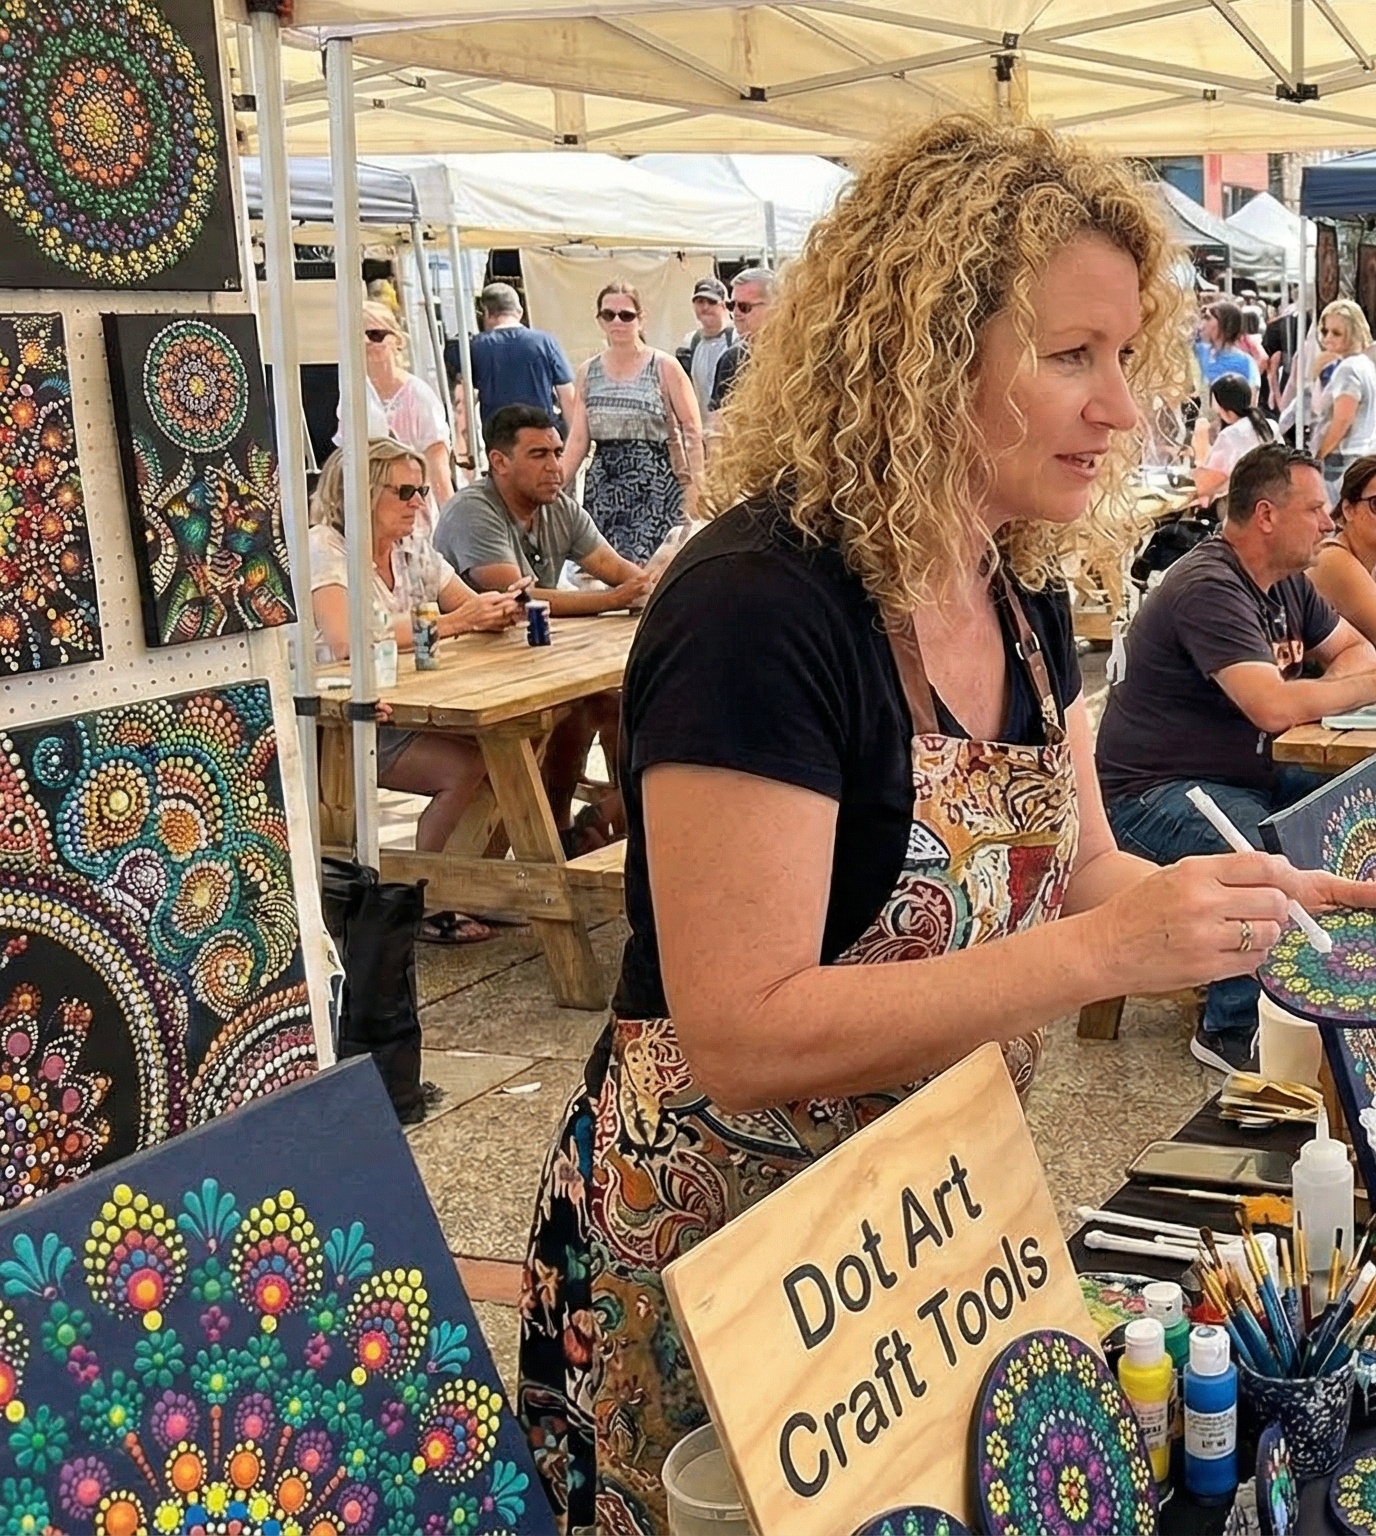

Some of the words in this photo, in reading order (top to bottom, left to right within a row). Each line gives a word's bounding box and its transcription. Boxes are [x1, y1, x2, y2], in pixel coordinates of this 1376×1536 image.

[779, 1330, 927, 1498] Craft
[917, 1235, 1048, 1366] Tools
[782, 1219, 898, 1350] Dot
[902, 1155, 983, 1269] Art
